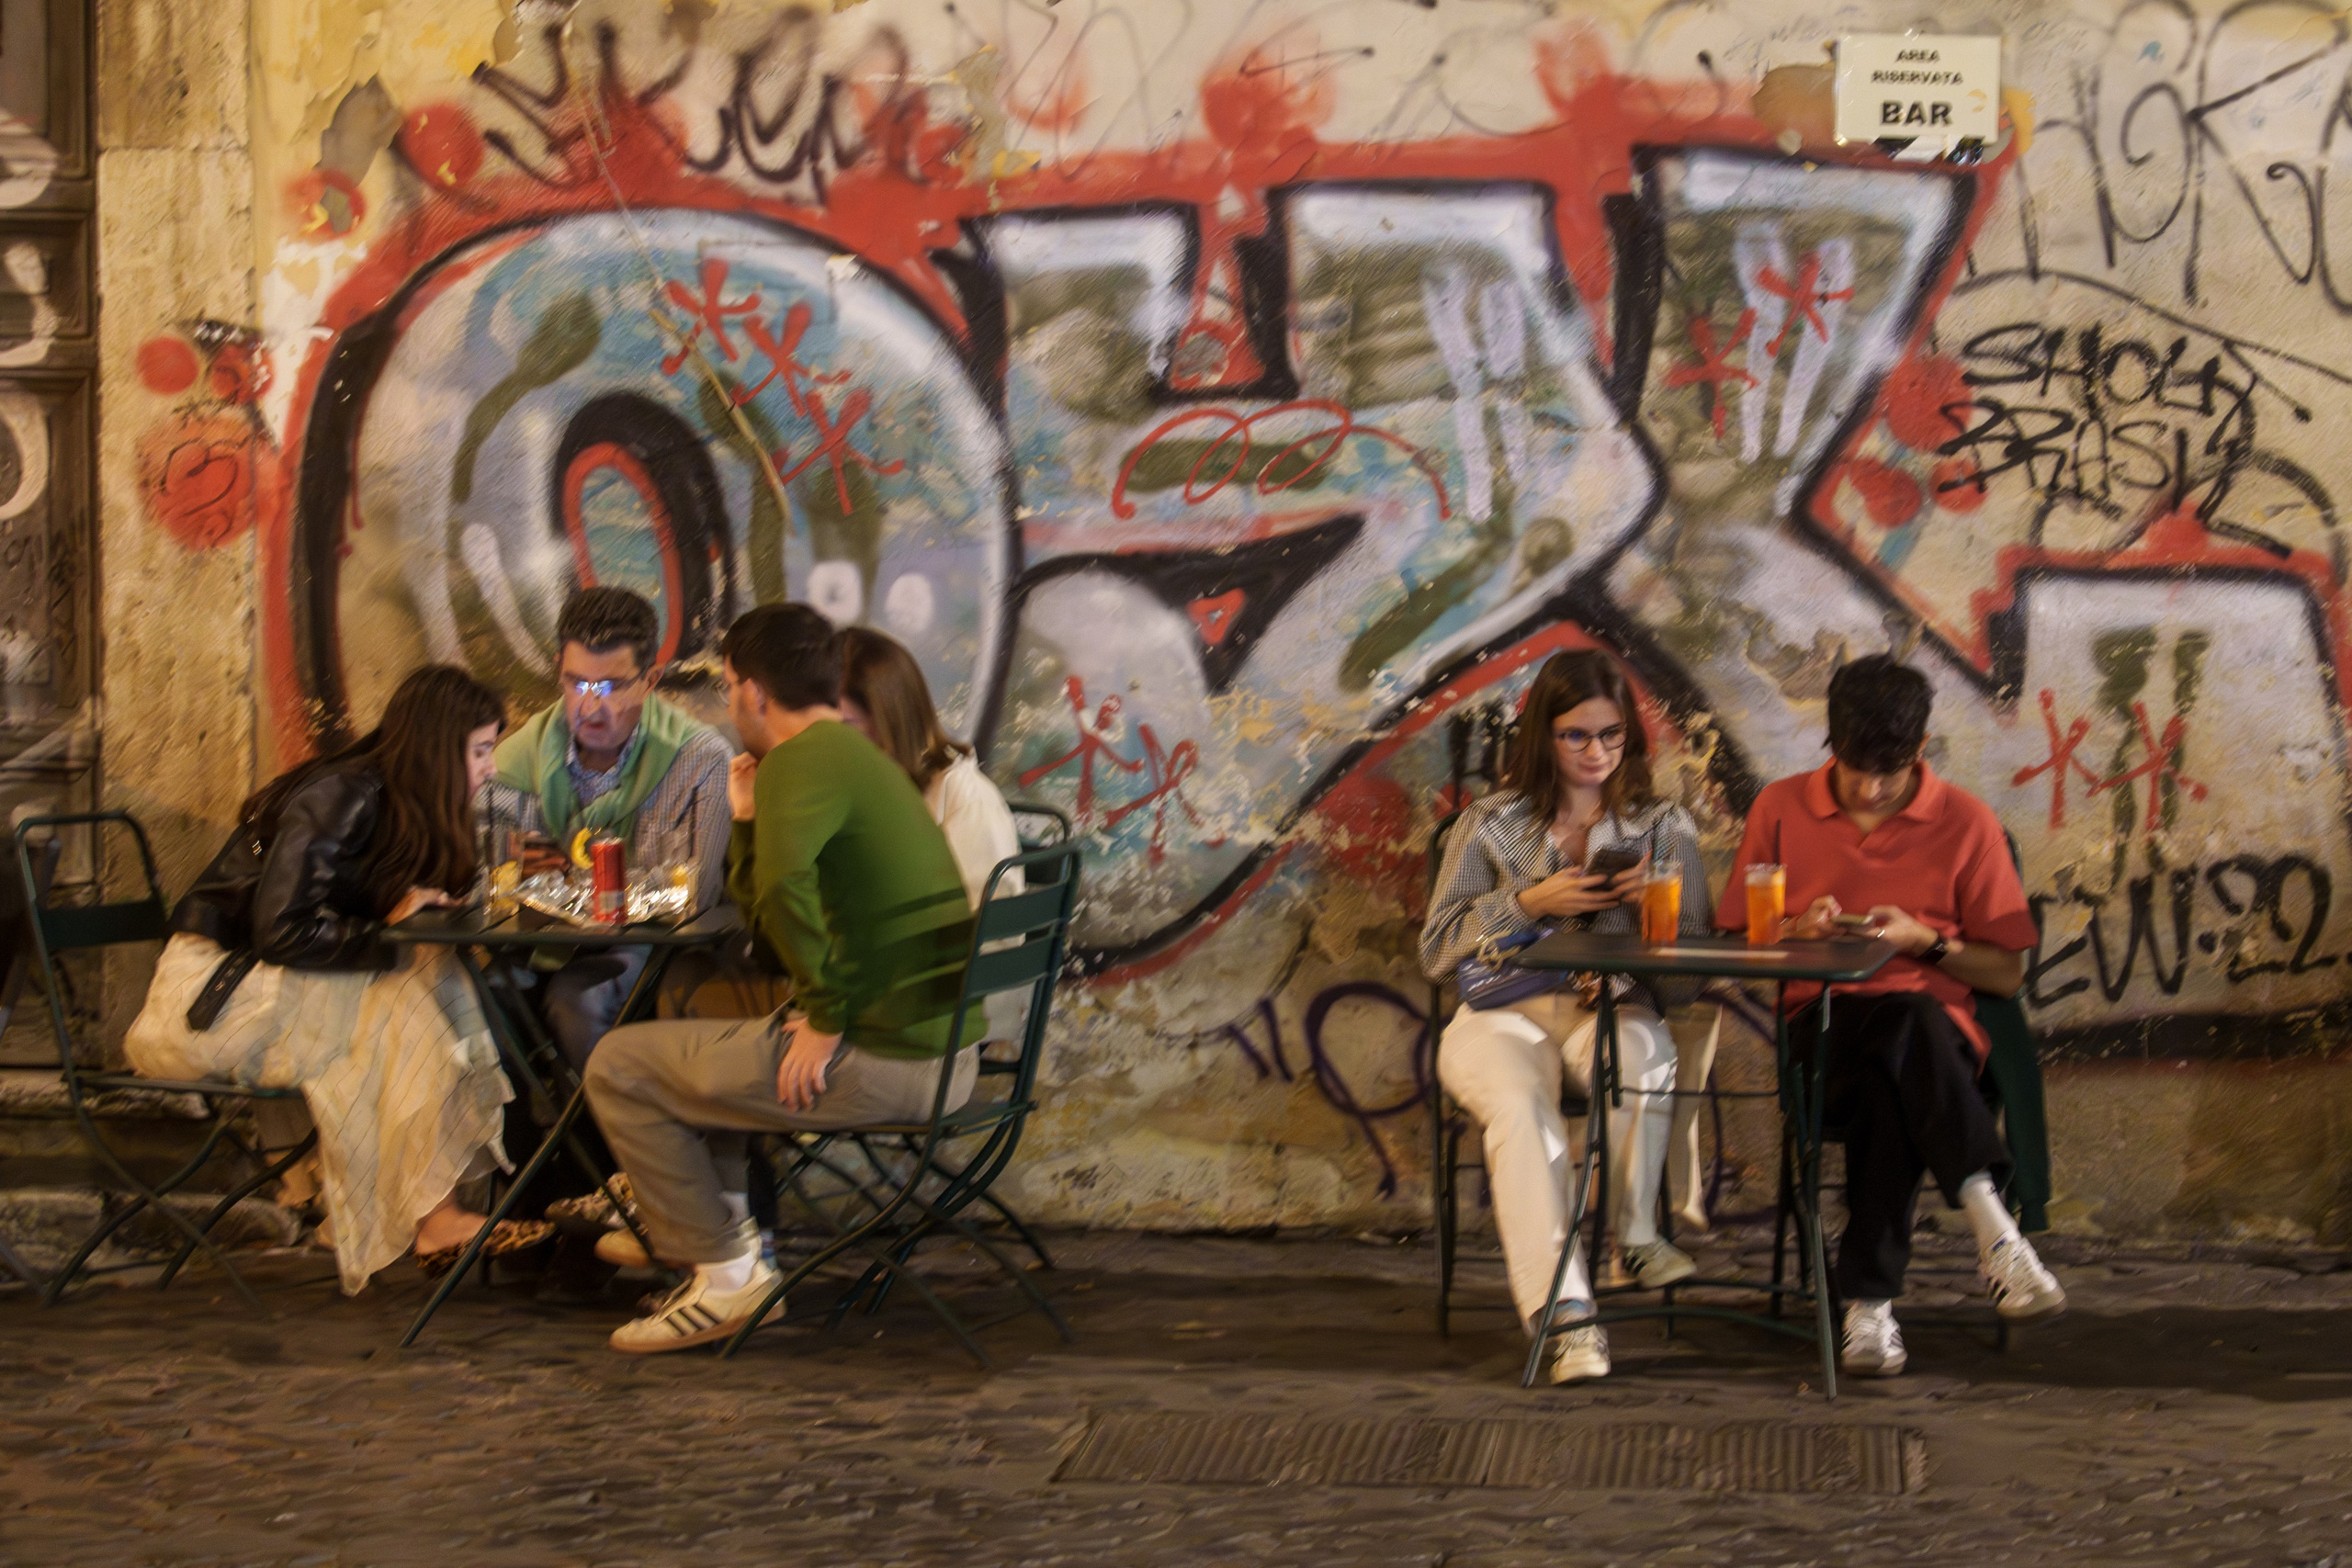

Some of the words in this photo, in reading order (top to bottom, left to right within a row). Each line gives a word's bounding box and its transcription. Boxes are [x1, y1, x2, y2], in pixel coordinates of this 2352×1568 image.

[1895, 50, 1939, 62] AREA
[1871, 70, 1963, 85] RISERVATA
[1881, 100, 1953, 126] BAR
